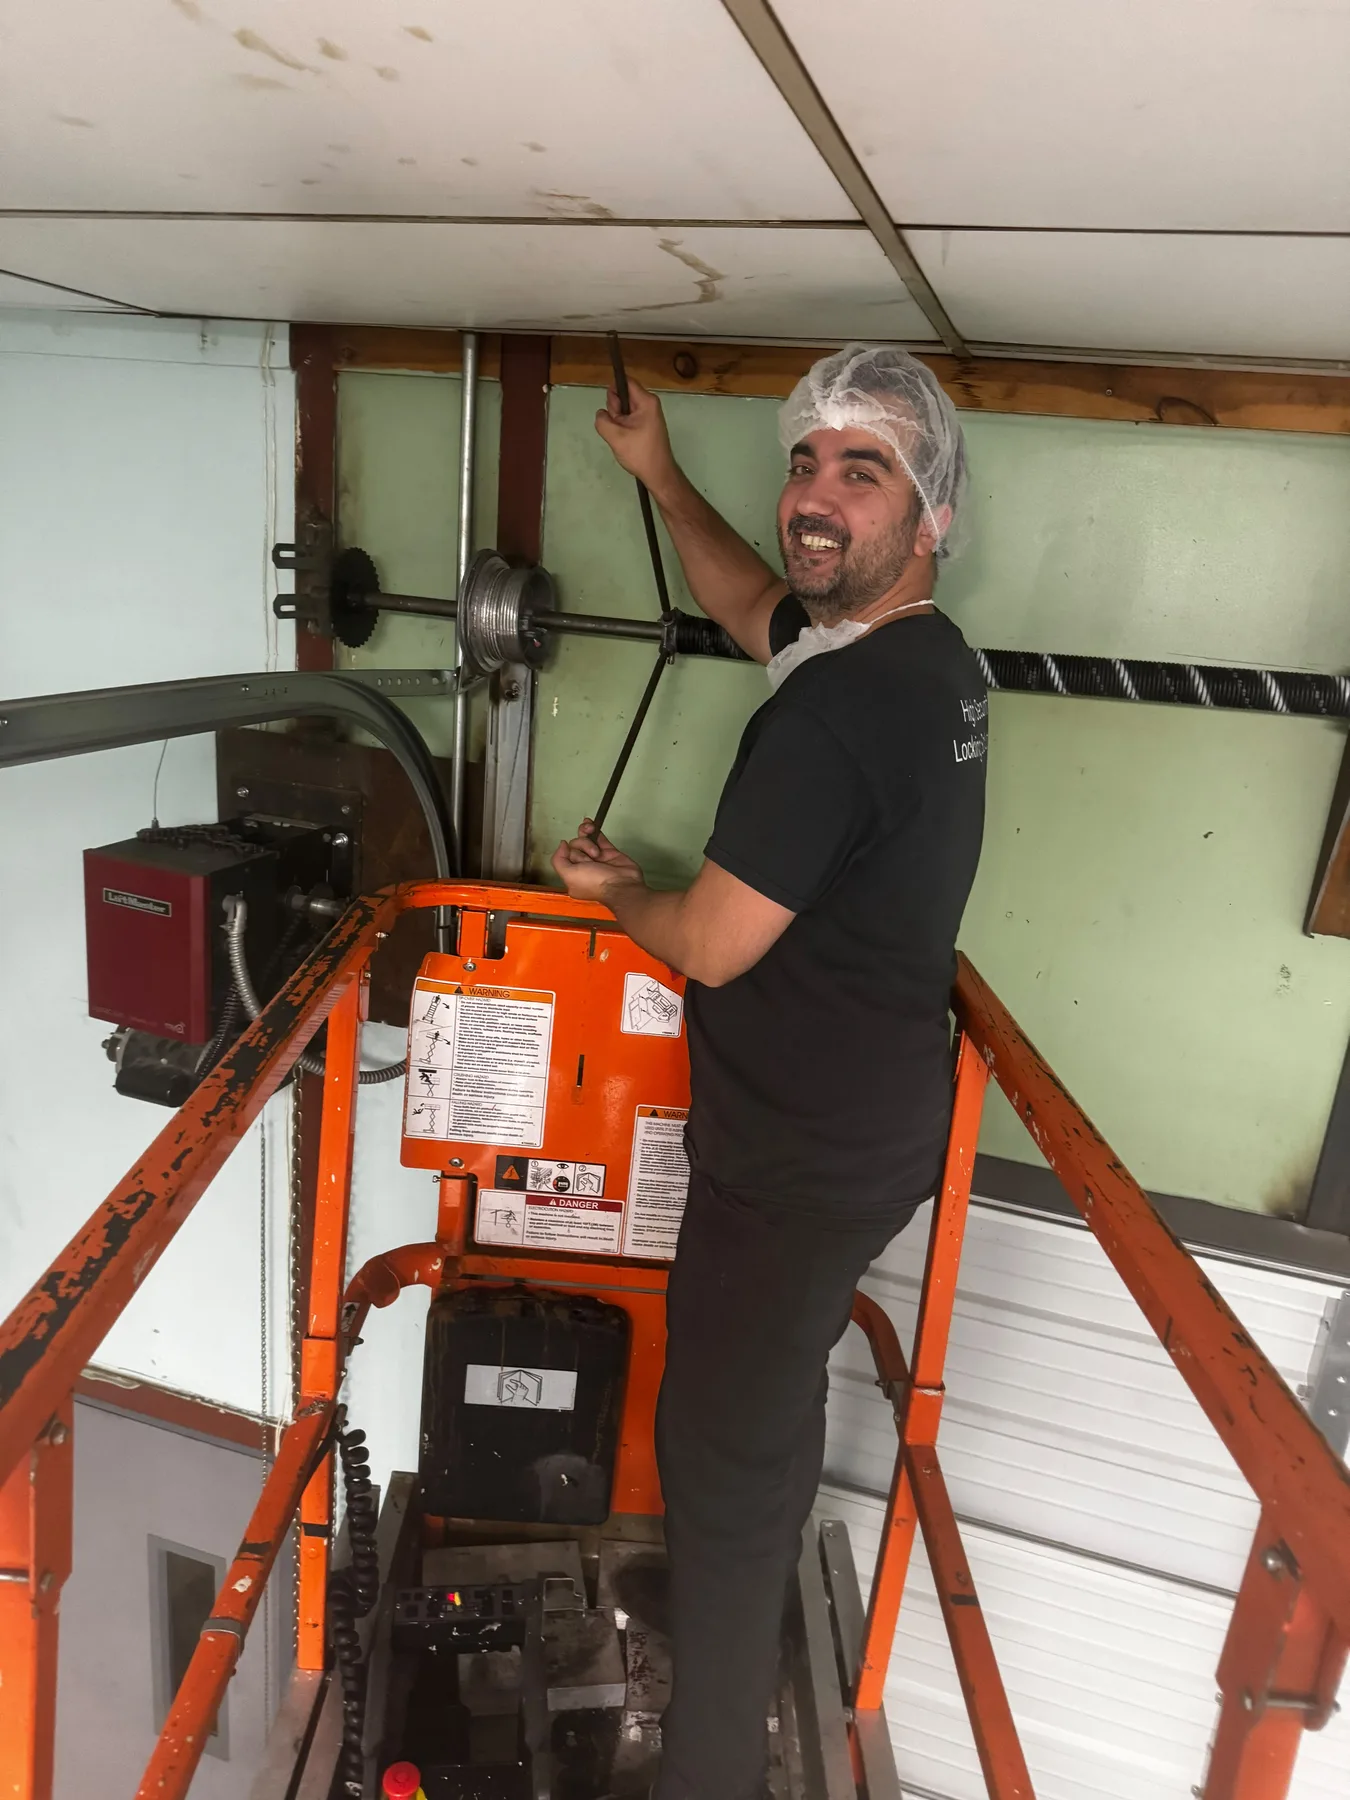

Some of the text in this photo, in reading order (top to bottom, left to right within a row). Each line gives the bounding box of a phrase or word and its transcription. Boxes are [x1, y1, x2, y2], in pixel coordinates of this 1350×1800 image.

[108, 892, 166, 913] LiftMaster
[468, 987, 511, 998] WARNING
[559, 1199, 599, 1209] DANGER
